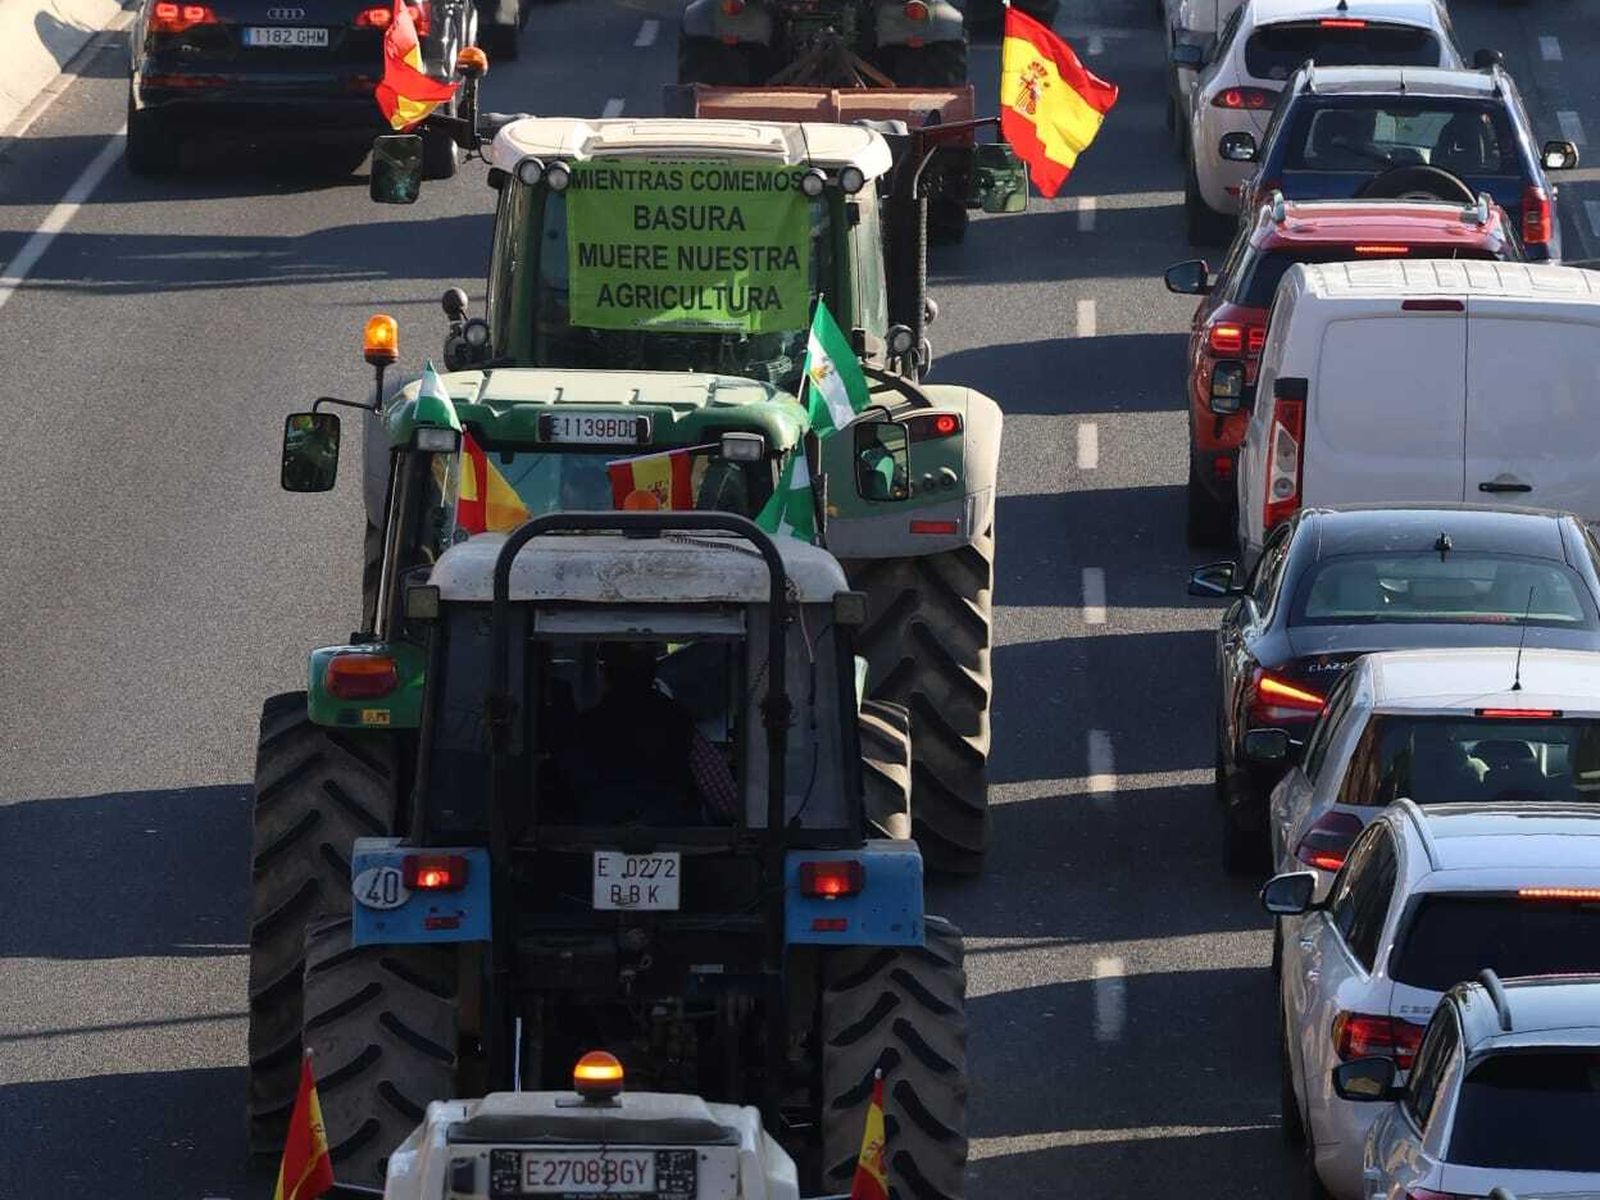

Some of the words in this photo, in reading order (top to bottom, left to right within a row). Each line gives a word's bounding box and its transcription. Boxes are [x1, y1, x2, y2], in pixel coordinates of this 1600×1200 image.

[255, 28, 292, 43] 1182
[571, 169, 684, 191] MIENTRAS
[690, 171, 801, 192] COMEMOS
[633, 204, 746, 232] BASURA
[578, 242, 669, 271] MUERE
[677, 245, 801, 272] NUESTRA
[596, 283, 783, 316] AGRICULTURA
[626, 857, 676, 878] 0272
[365, 870, 399, 904] 40
[525, 1158, 648, 1186] E2708BGY
